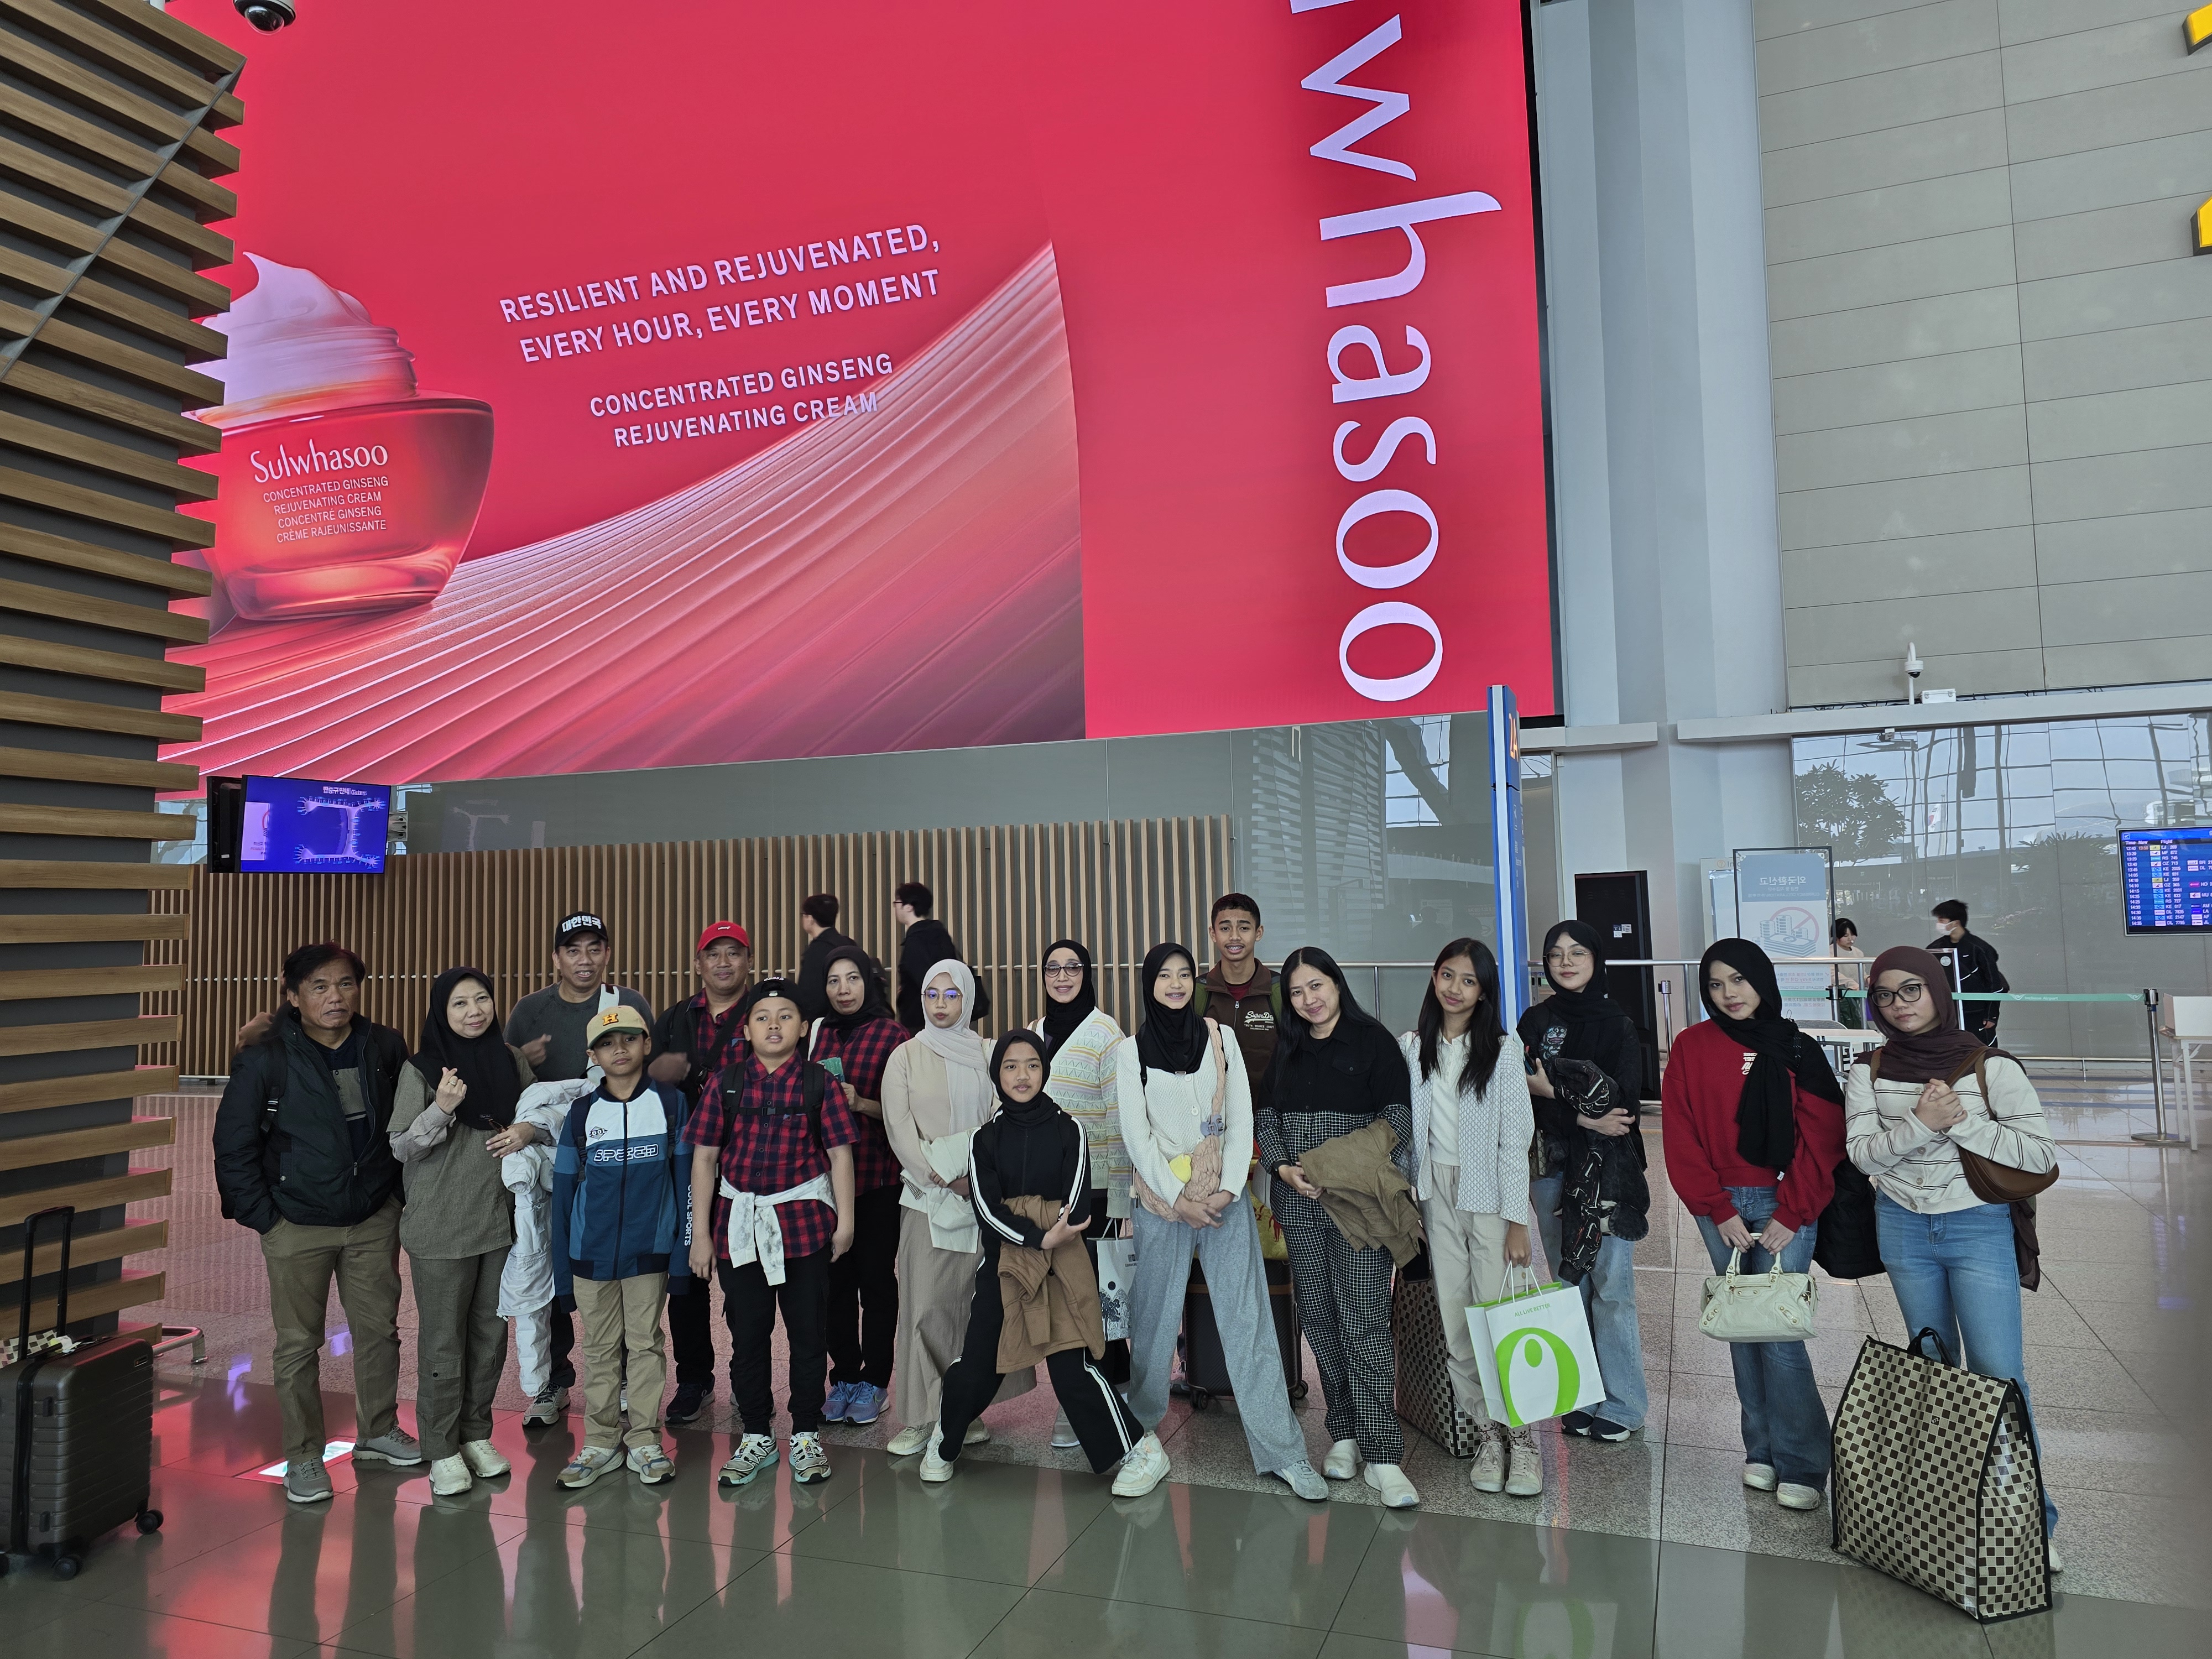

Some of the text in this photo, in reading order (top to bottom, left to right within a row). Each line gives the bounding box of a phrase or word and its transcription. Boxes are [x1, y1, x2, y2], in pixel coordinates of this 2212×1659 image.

[499, 223, 940, 322] RESILIENT AND REJUVENATED,
[520, 269, 940, 362] EVERY HOUR, EVERY MOMENT
[1290, 0, 1502, 701] whasoo
[590, 353, 893, 417] CONCENTRATED GINSENG
[614, 392, 878, 447] REJUVENATING CREAM
[251, 439, 388, 483] Sulwhasoo
[263, 476, 388, 503] CONCENTRATED GINSENG
[274, 491, 382, 515] REJUVENATING CREAM
[276, 520, 387, 542] CRÈME RAJEUNISSANTE
[278, 506, 382, 528] CONCENTRÉ GINSENG
[1509, 713, 1519, 762] 2A
[562, 915, 601, 932] 대한민국
[602, 1013, 619, 1026] H
[593, 1144, 659, 1162] SPEED
[684, 1211, 693, 1246] SPORTS
[1533, 1303, 1551, 1312] BETTER
